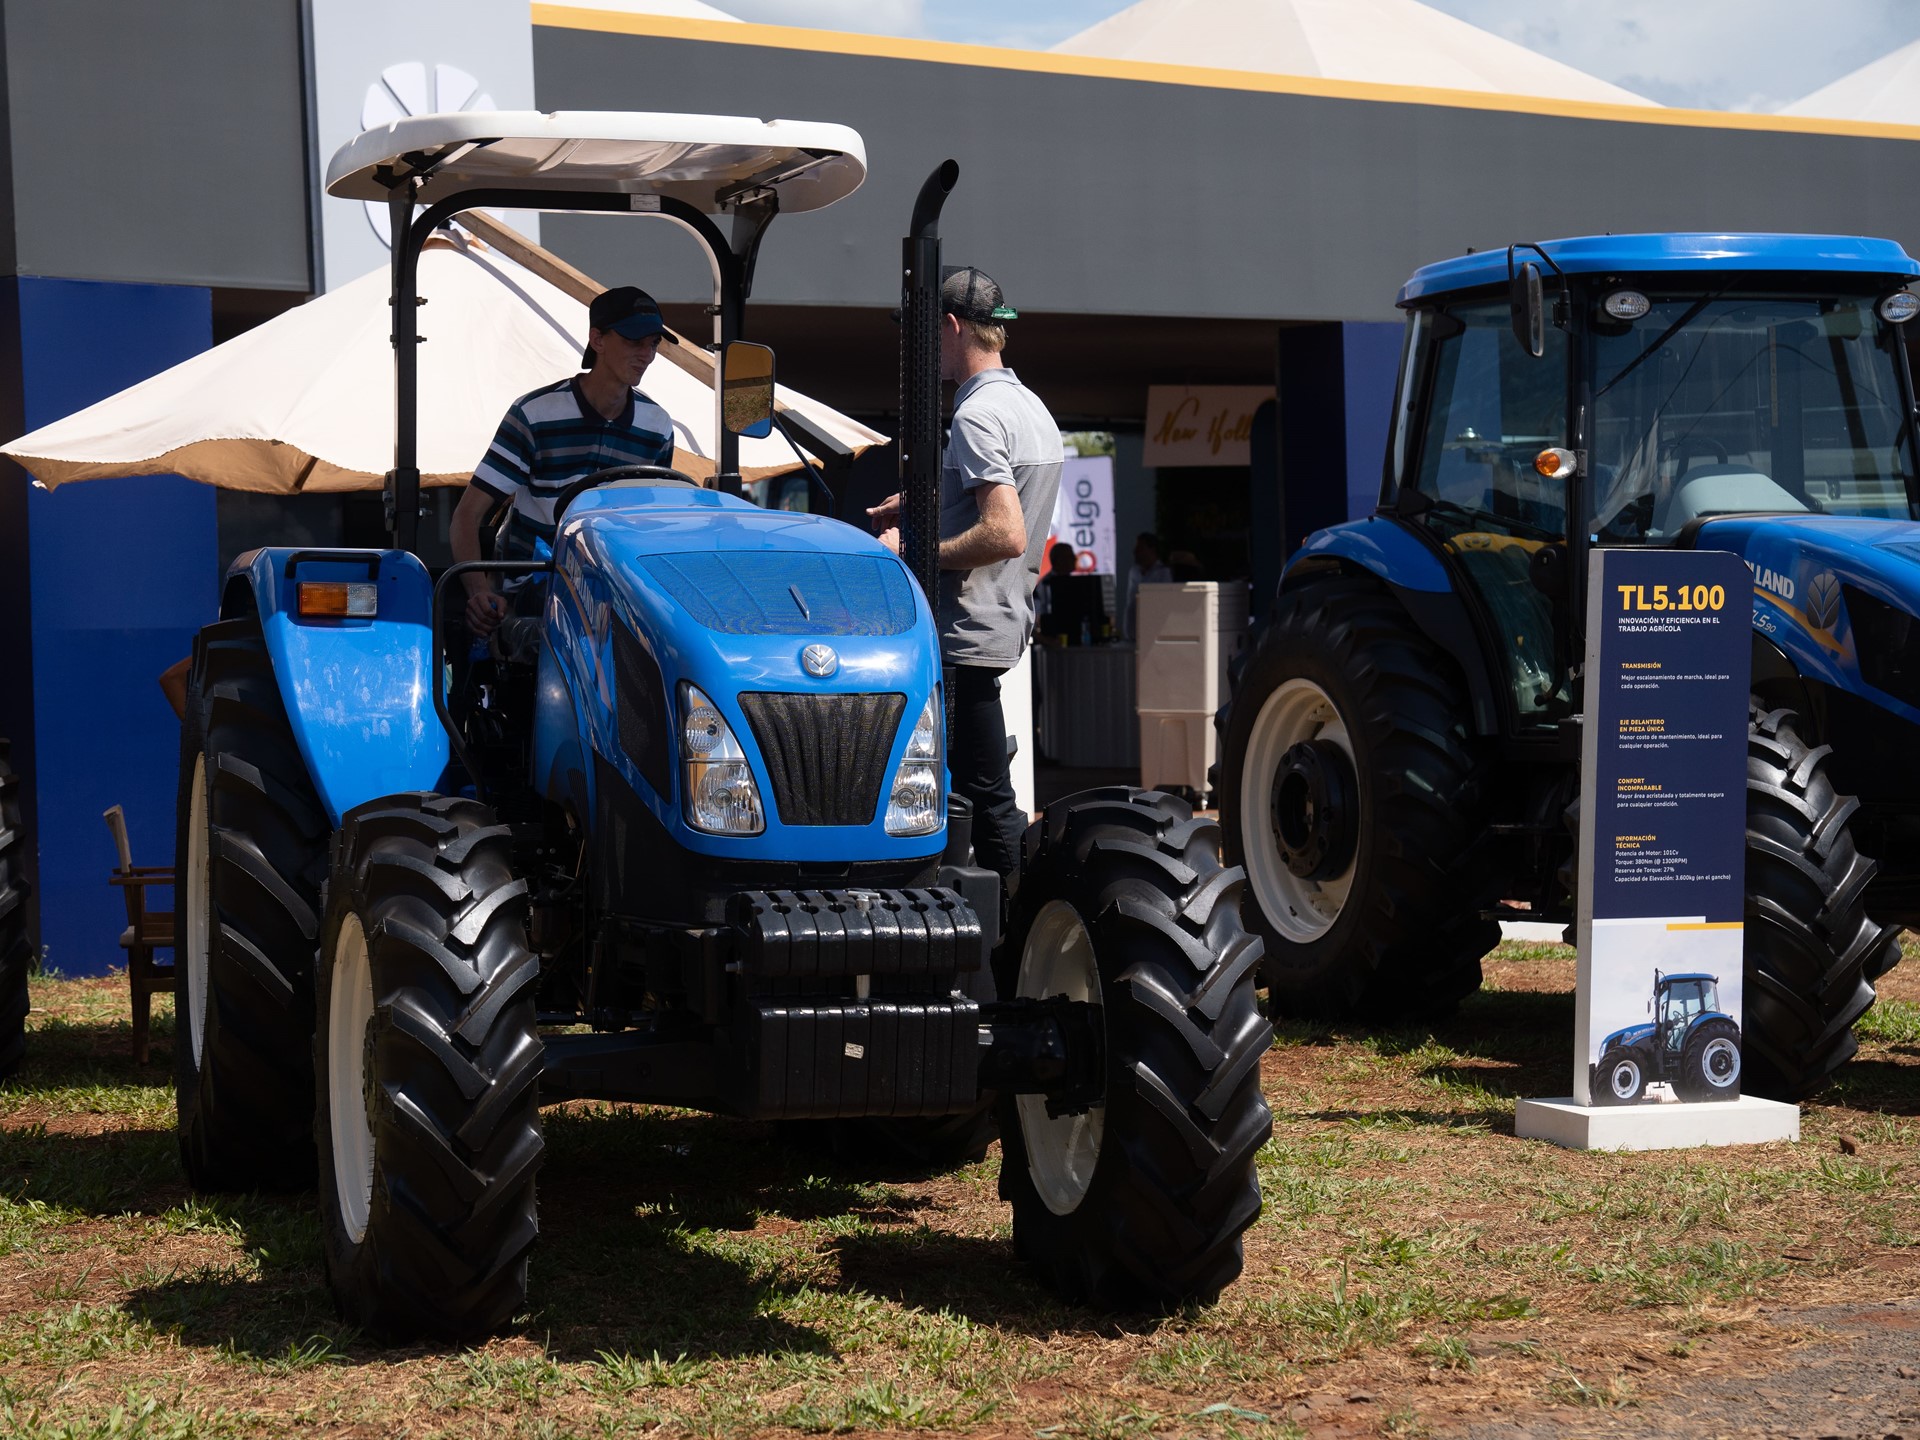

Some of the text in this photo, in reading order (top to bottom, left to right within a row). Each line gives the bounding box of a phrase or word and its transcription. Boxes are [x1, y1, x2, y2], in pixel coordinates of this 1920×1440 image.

[1154, 397, 1199, 446] New
[1617, 584, 1725, 611] TL5.100
[1618, 616, 1659, 624] INNOVACIÓN
[1648, 624, 1682, 632] AGRÍCOLA
[1621, 674, 1636, 682] Mejor
[1615, 834, 1656, 842] INFORMACIÓN
[1615, 841, 1641, 849] TÉCNICA
